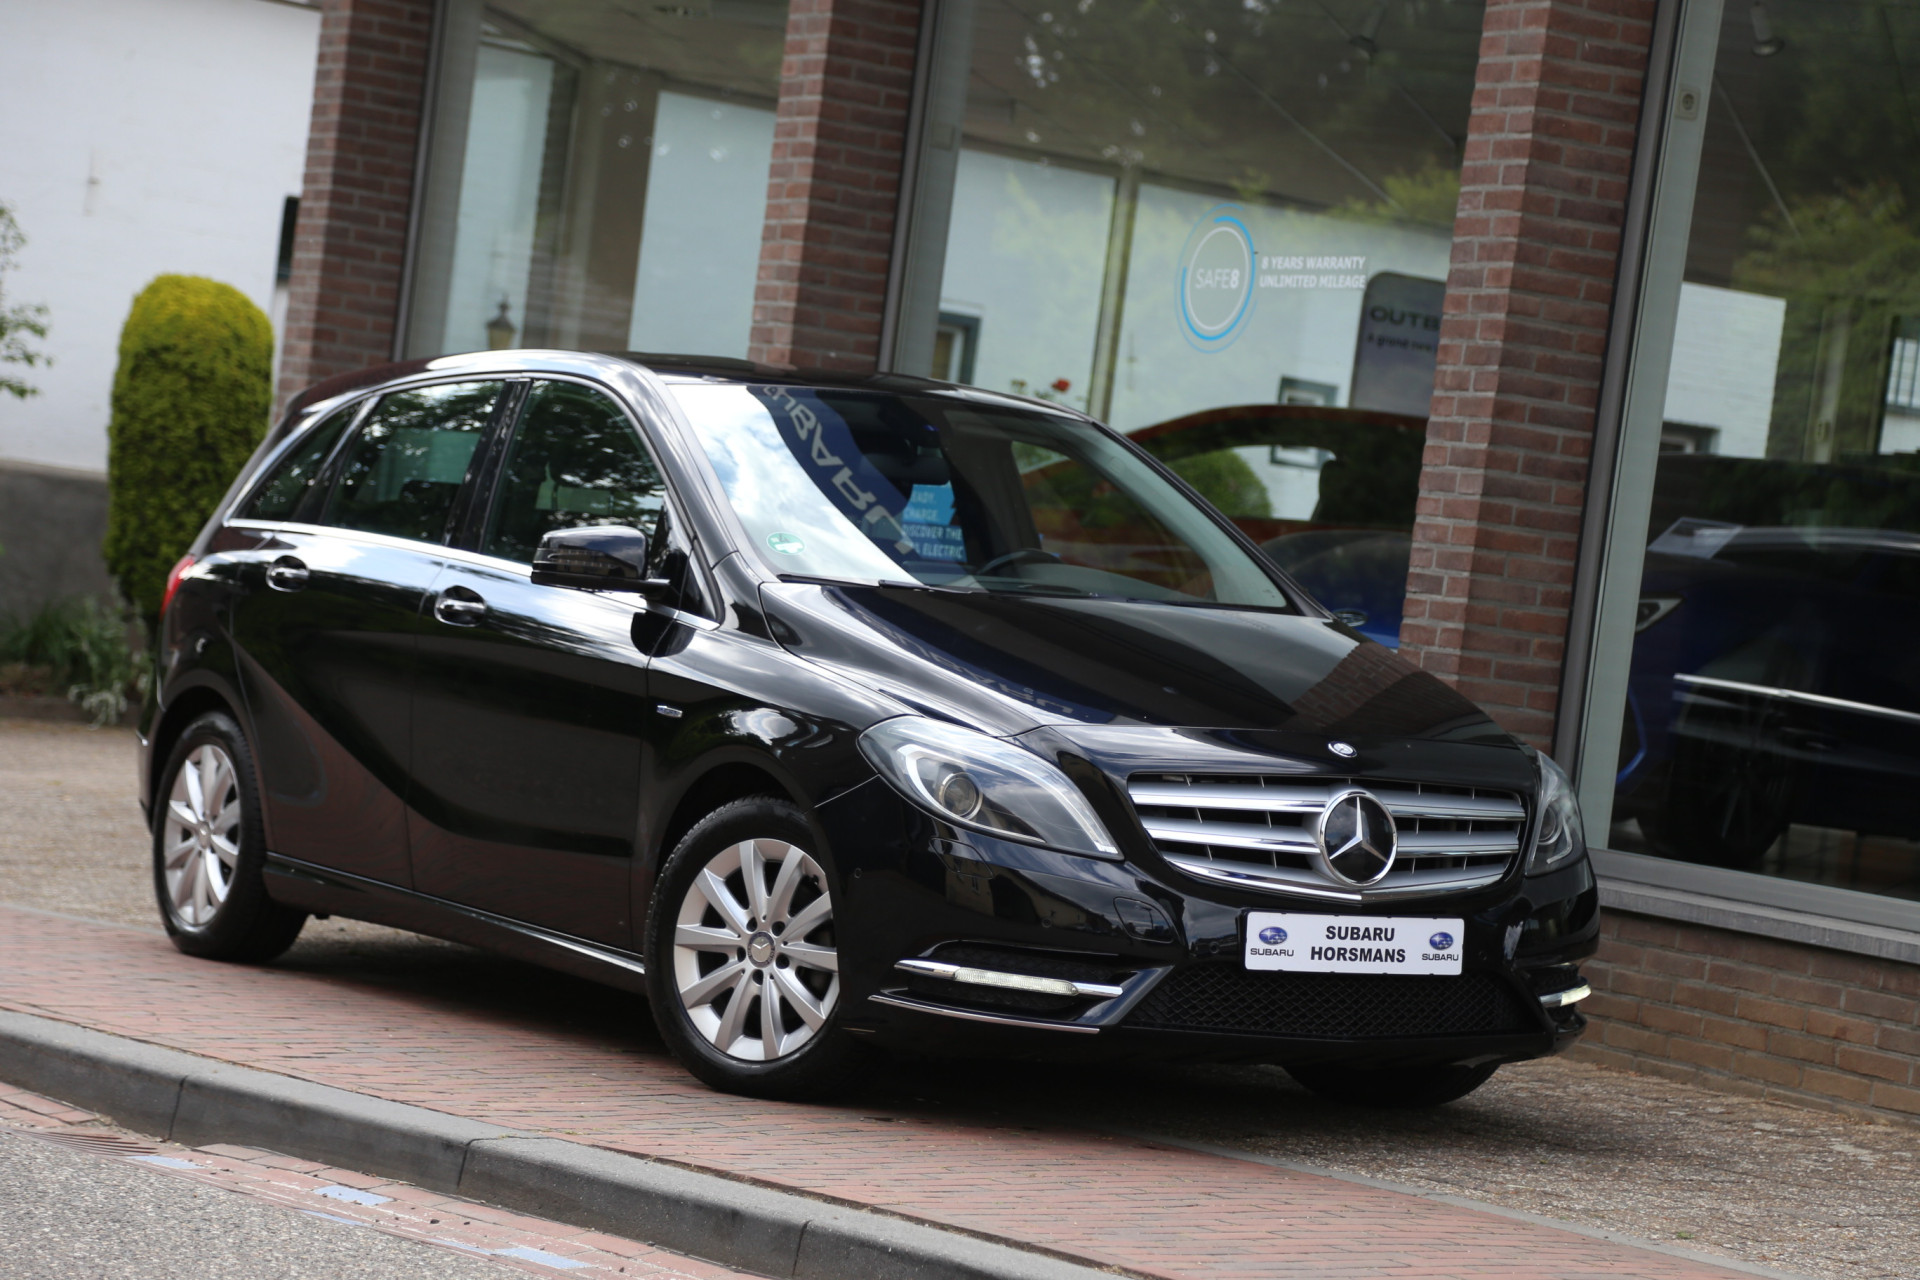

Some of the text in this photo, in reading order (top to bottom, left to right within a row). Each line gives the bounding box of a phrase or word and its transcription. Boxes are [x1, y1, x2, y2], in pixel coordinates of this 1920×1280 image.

[1261, 255, 1366, 271] 8 YEARS WARRANTY
[1195, 268, 1241, 289] SAFE8
[1259, 274, 1366, 289] UNLIMITED MILEAGE
[945, 527, 962, 541] THE
[922, 542, 964, 559] ELECTRIC
[1325, 925, 1396, 942] SUBARU
[1250, 947, 1295, 957] SUBARU
[1310, 946, 1406, 963] HORSMANS
[1421, 953, 1460, 962] SUBARU
